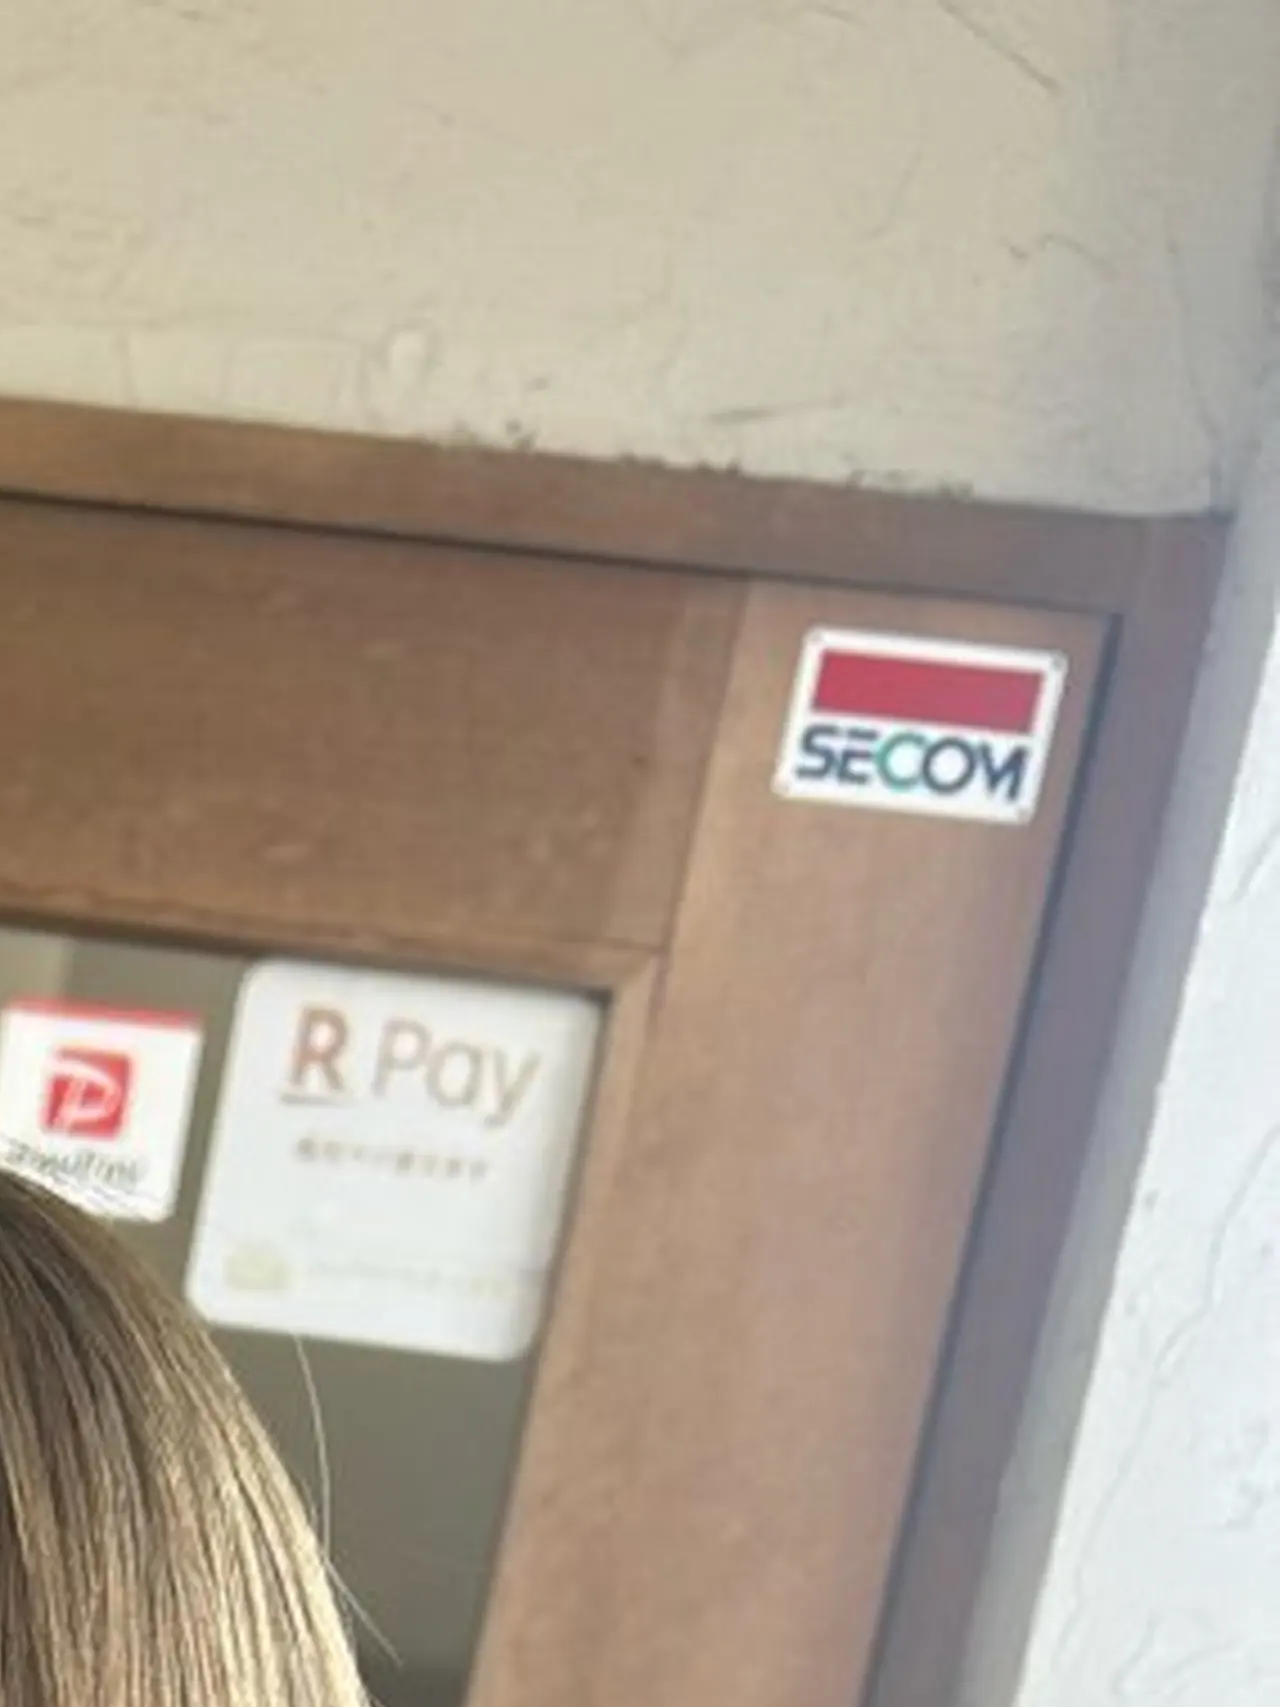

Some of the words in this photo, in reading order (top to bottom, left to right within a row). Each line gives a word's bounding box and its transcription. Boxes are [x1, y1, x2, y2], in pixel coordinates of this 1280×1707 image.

[795, 725, 1029, 803] SECOM
[286, 1004, 350, 1092] R
[372, 1017, 540, 1128] Pay
